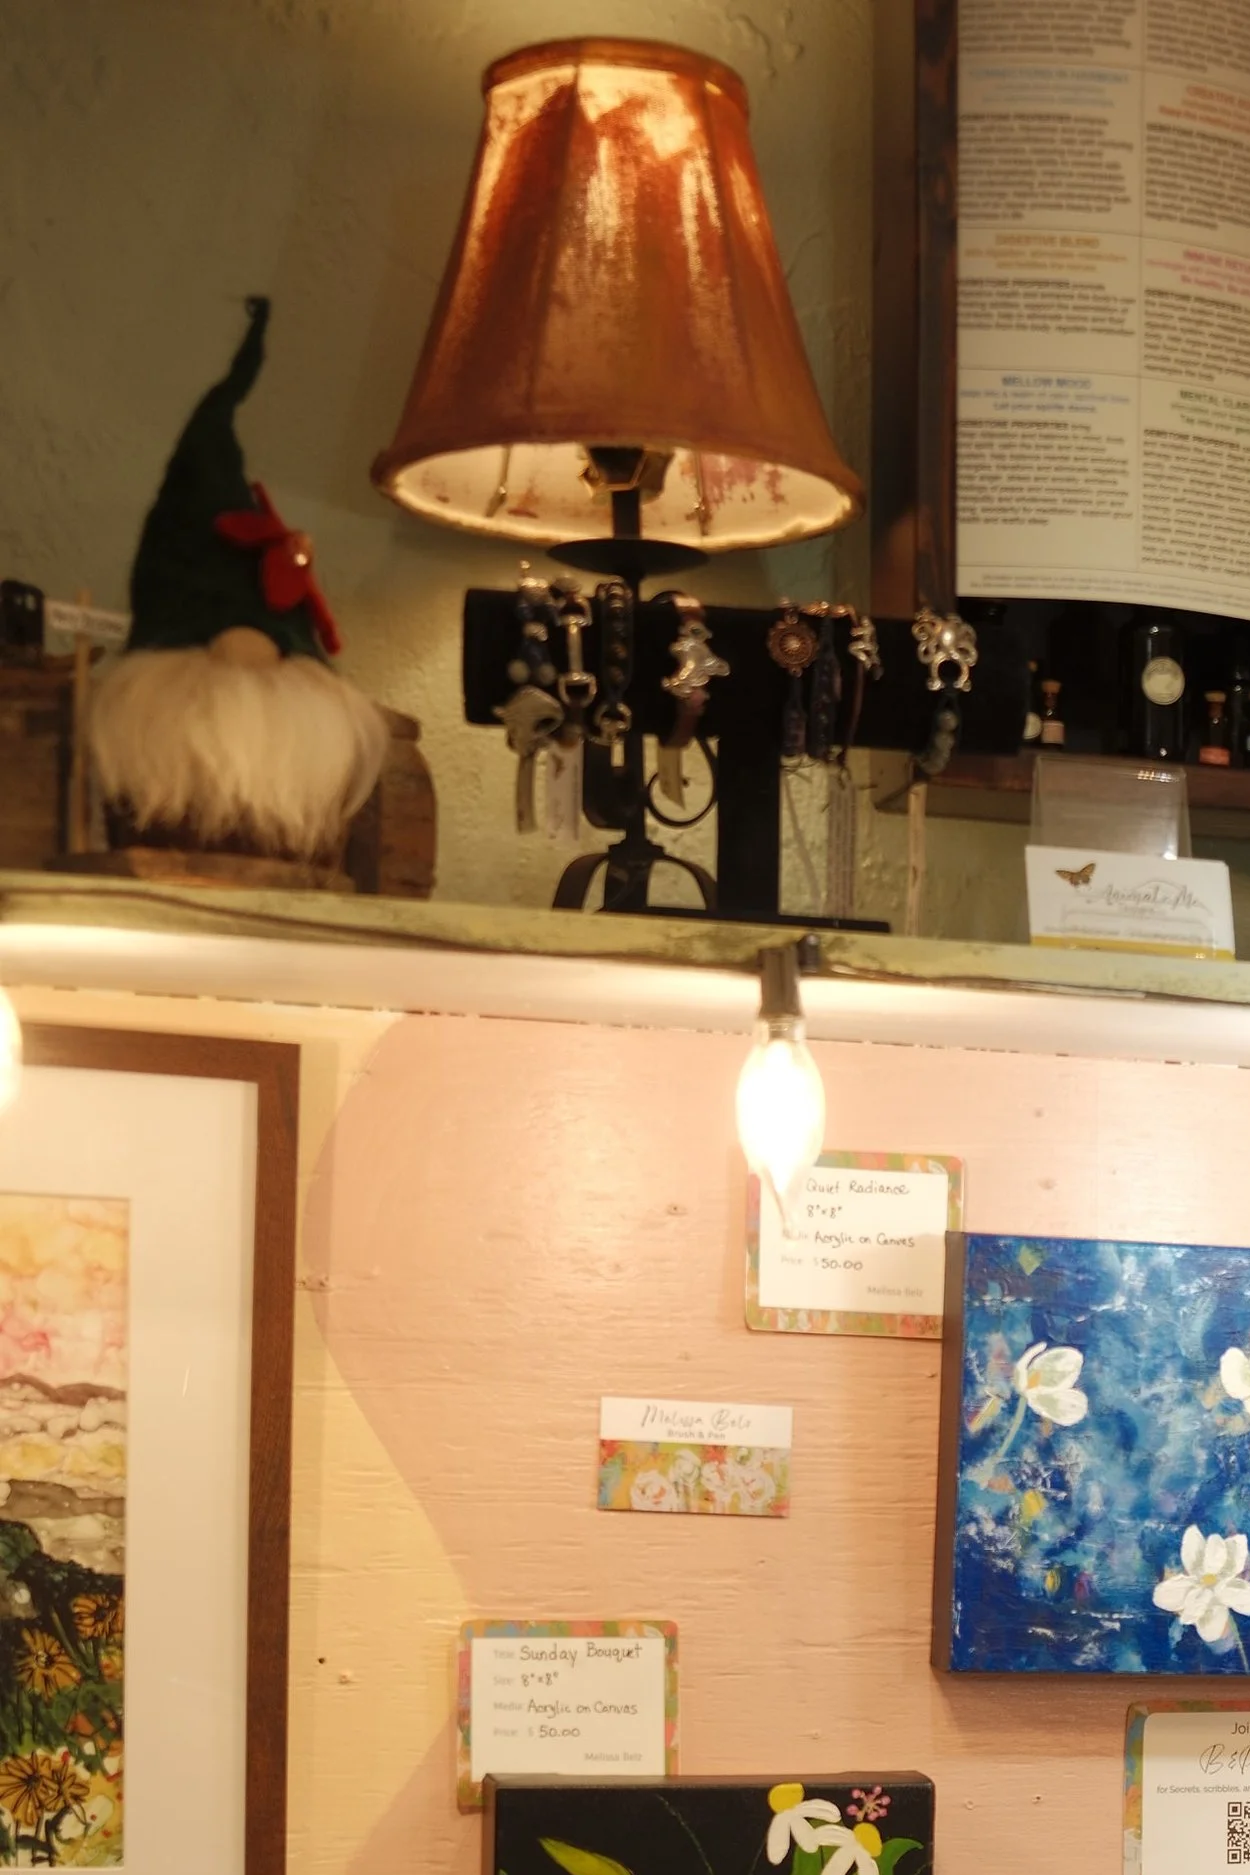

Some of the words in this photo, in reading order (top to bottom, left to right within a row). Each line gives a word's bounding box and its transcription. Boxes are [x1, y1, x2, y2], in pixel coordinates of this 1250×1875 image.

[806, 1179, 840, 1193] Quiet
[520, 1644, 578, 1667] Sunday
[586, 1642, 643, 1662] Bouquet
[527, 1700, 570, 1718] Acrylic
[576, 1706, 591, 1714] on
[594, 1701, 638, 1714] Canvas
[1157, 1785, 1168, 1794] for
